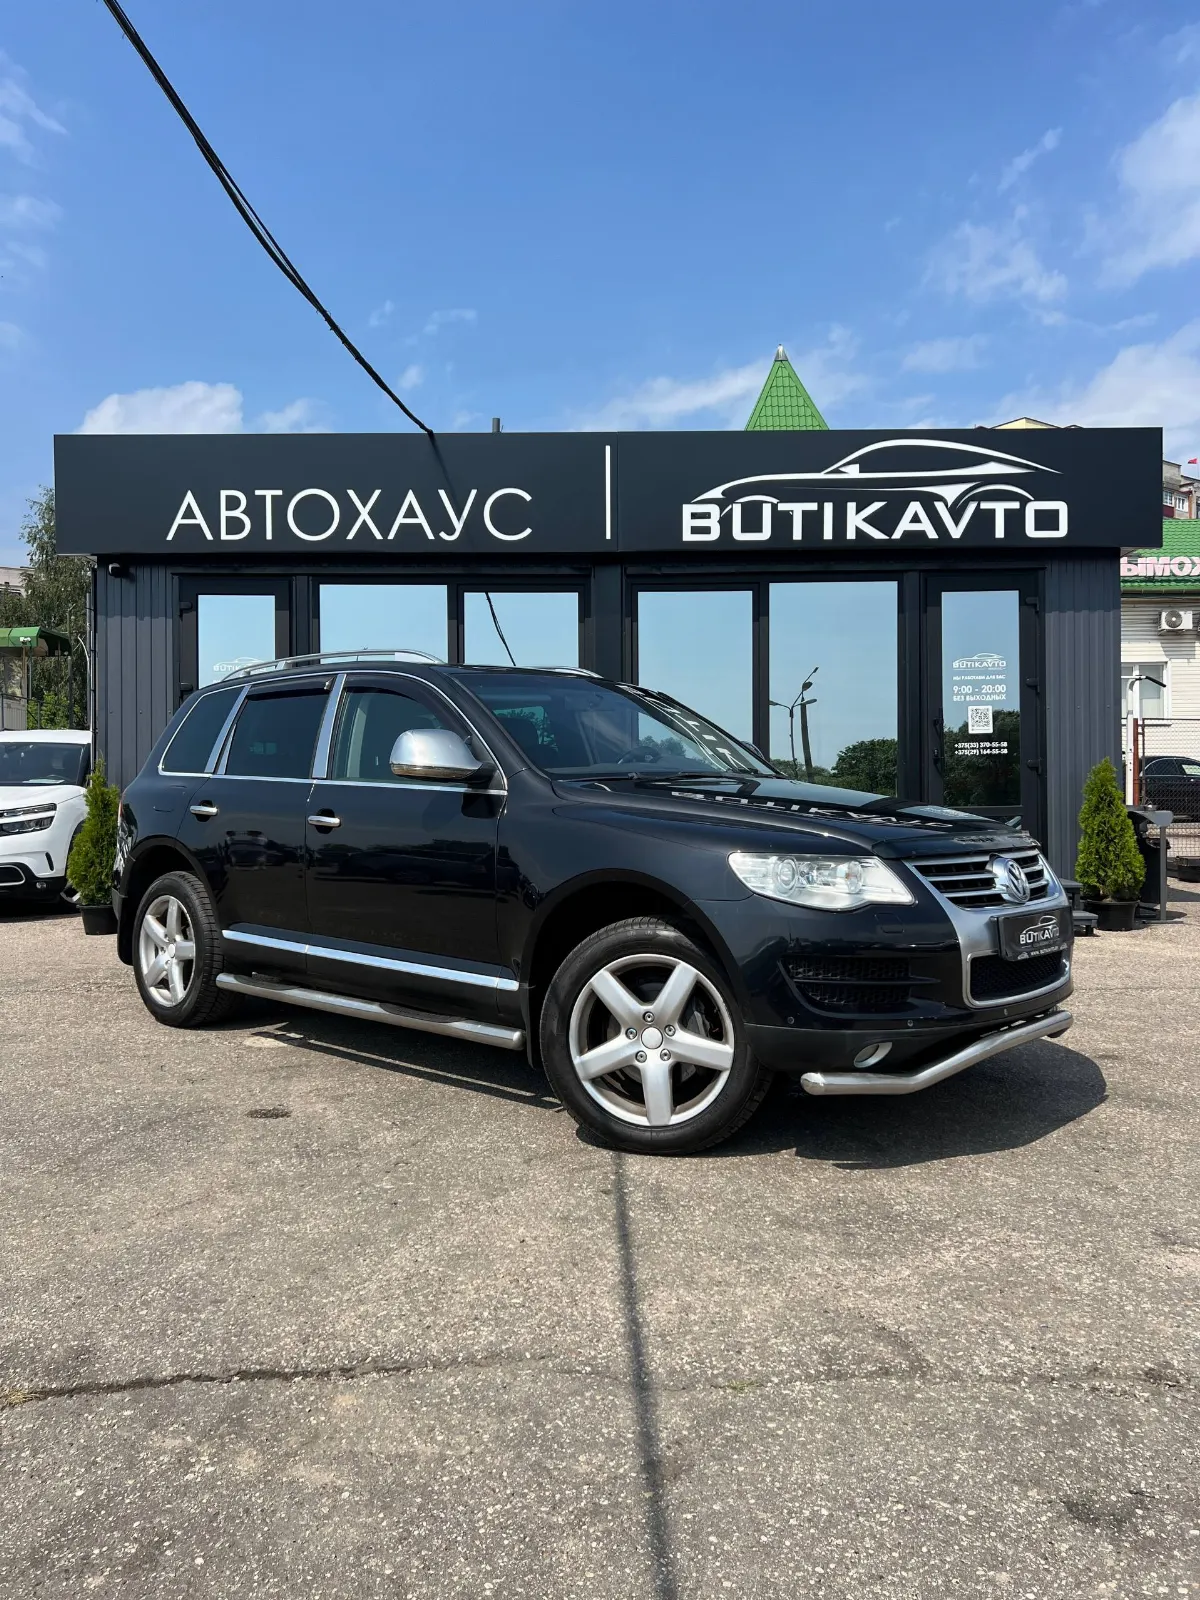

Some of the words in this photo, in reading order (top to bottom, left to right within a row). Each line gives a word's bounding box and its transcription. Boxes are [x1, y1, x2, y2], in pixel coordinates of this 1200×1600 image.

[166, 488, 532, 541] АВТОХАУС
[682, 500, 1068, 542] BUTIKAVTO
[953, 660, 1006, 668] BUTIKAVTO
[953, 685, 972, 694] 9:00
[981, 684, 1006, 693] 20:00
[966, 693, 1006, 701] ВЫХОДНЫХ
